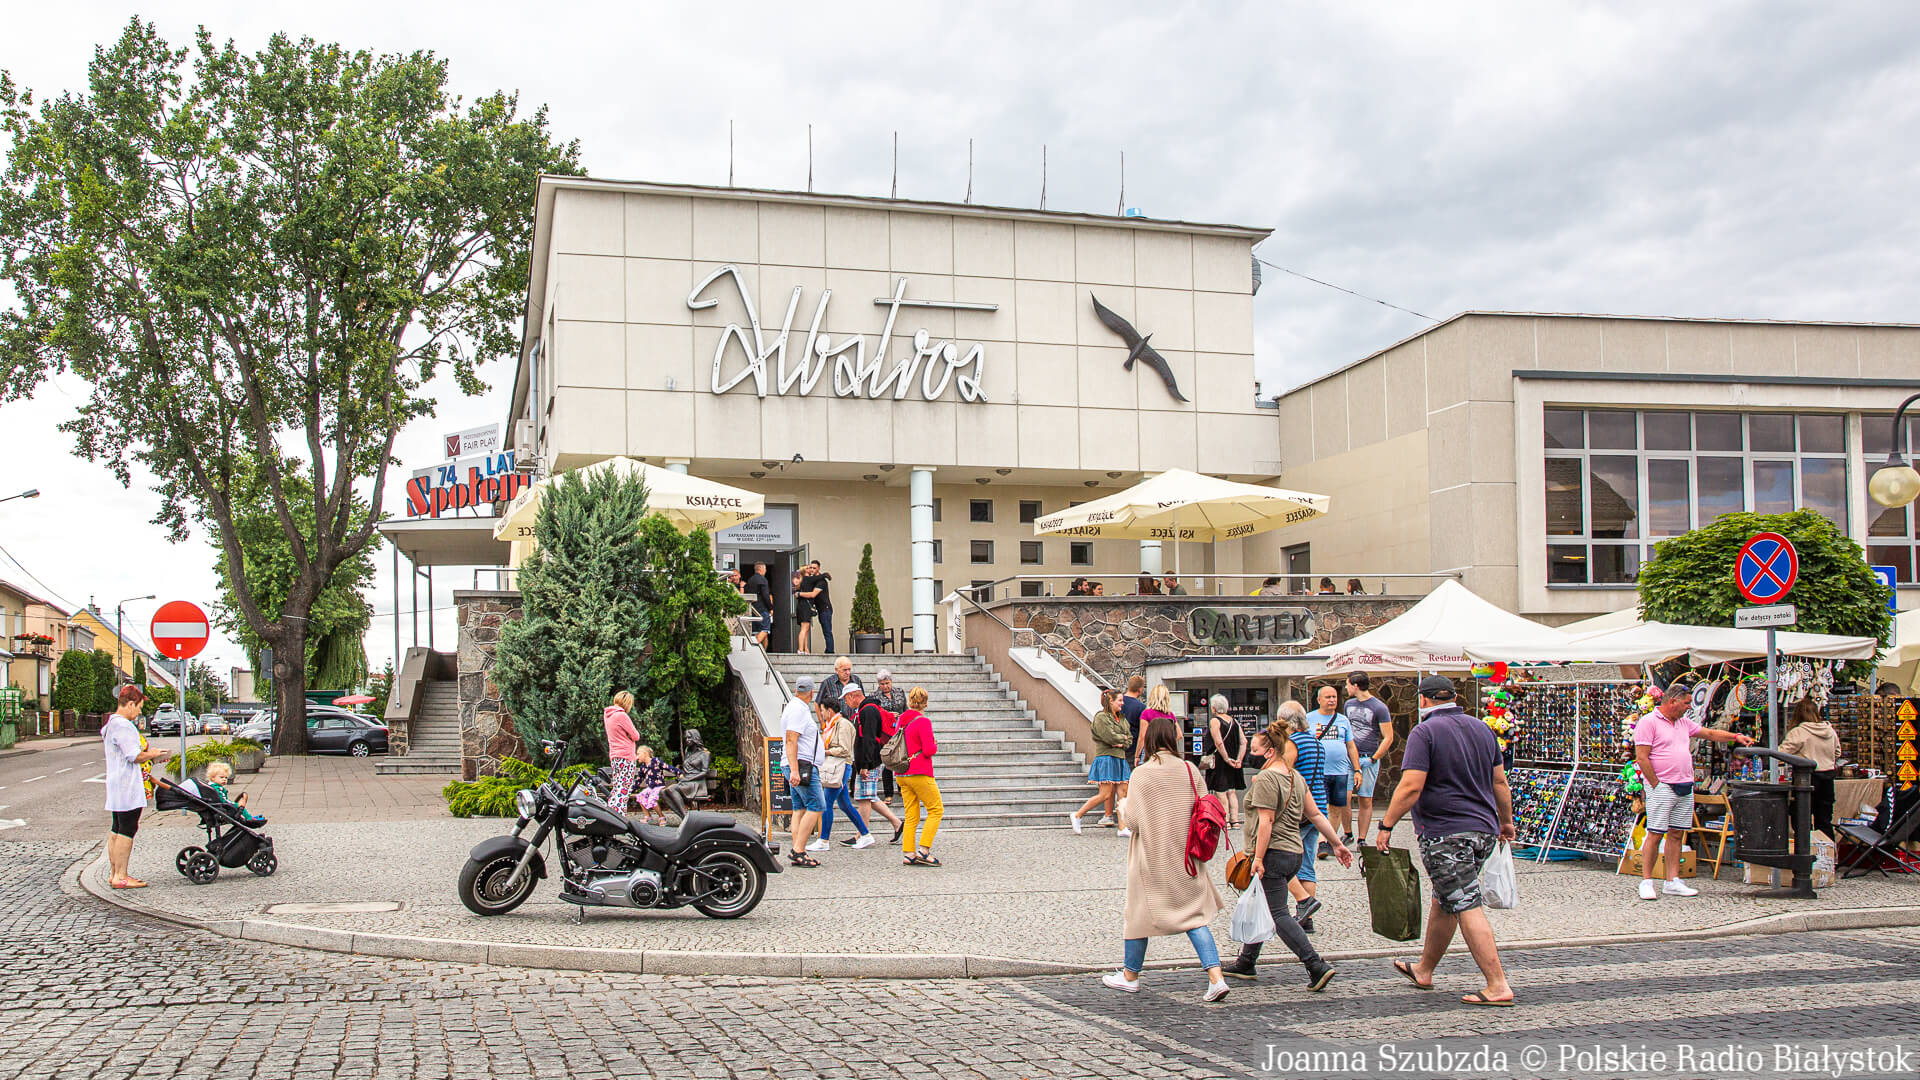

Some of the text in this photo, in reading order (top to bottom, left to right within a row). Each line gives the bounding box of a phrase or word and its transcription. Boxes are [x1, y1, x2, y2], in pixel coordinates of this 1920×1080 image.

[687, 263, 1000, 402] Albatros
[463, 436, 497, 451] FAIR PLAY
[438, 451, 514, 486] 74 LAT
[686, 495, 743, 509] KSIĄŻĘCE
[1774, 611, 1791, 619] zatoki
[1192, 613, 1310, 640] BARTEK
[1429, 653, 1471, 664] Restaura
